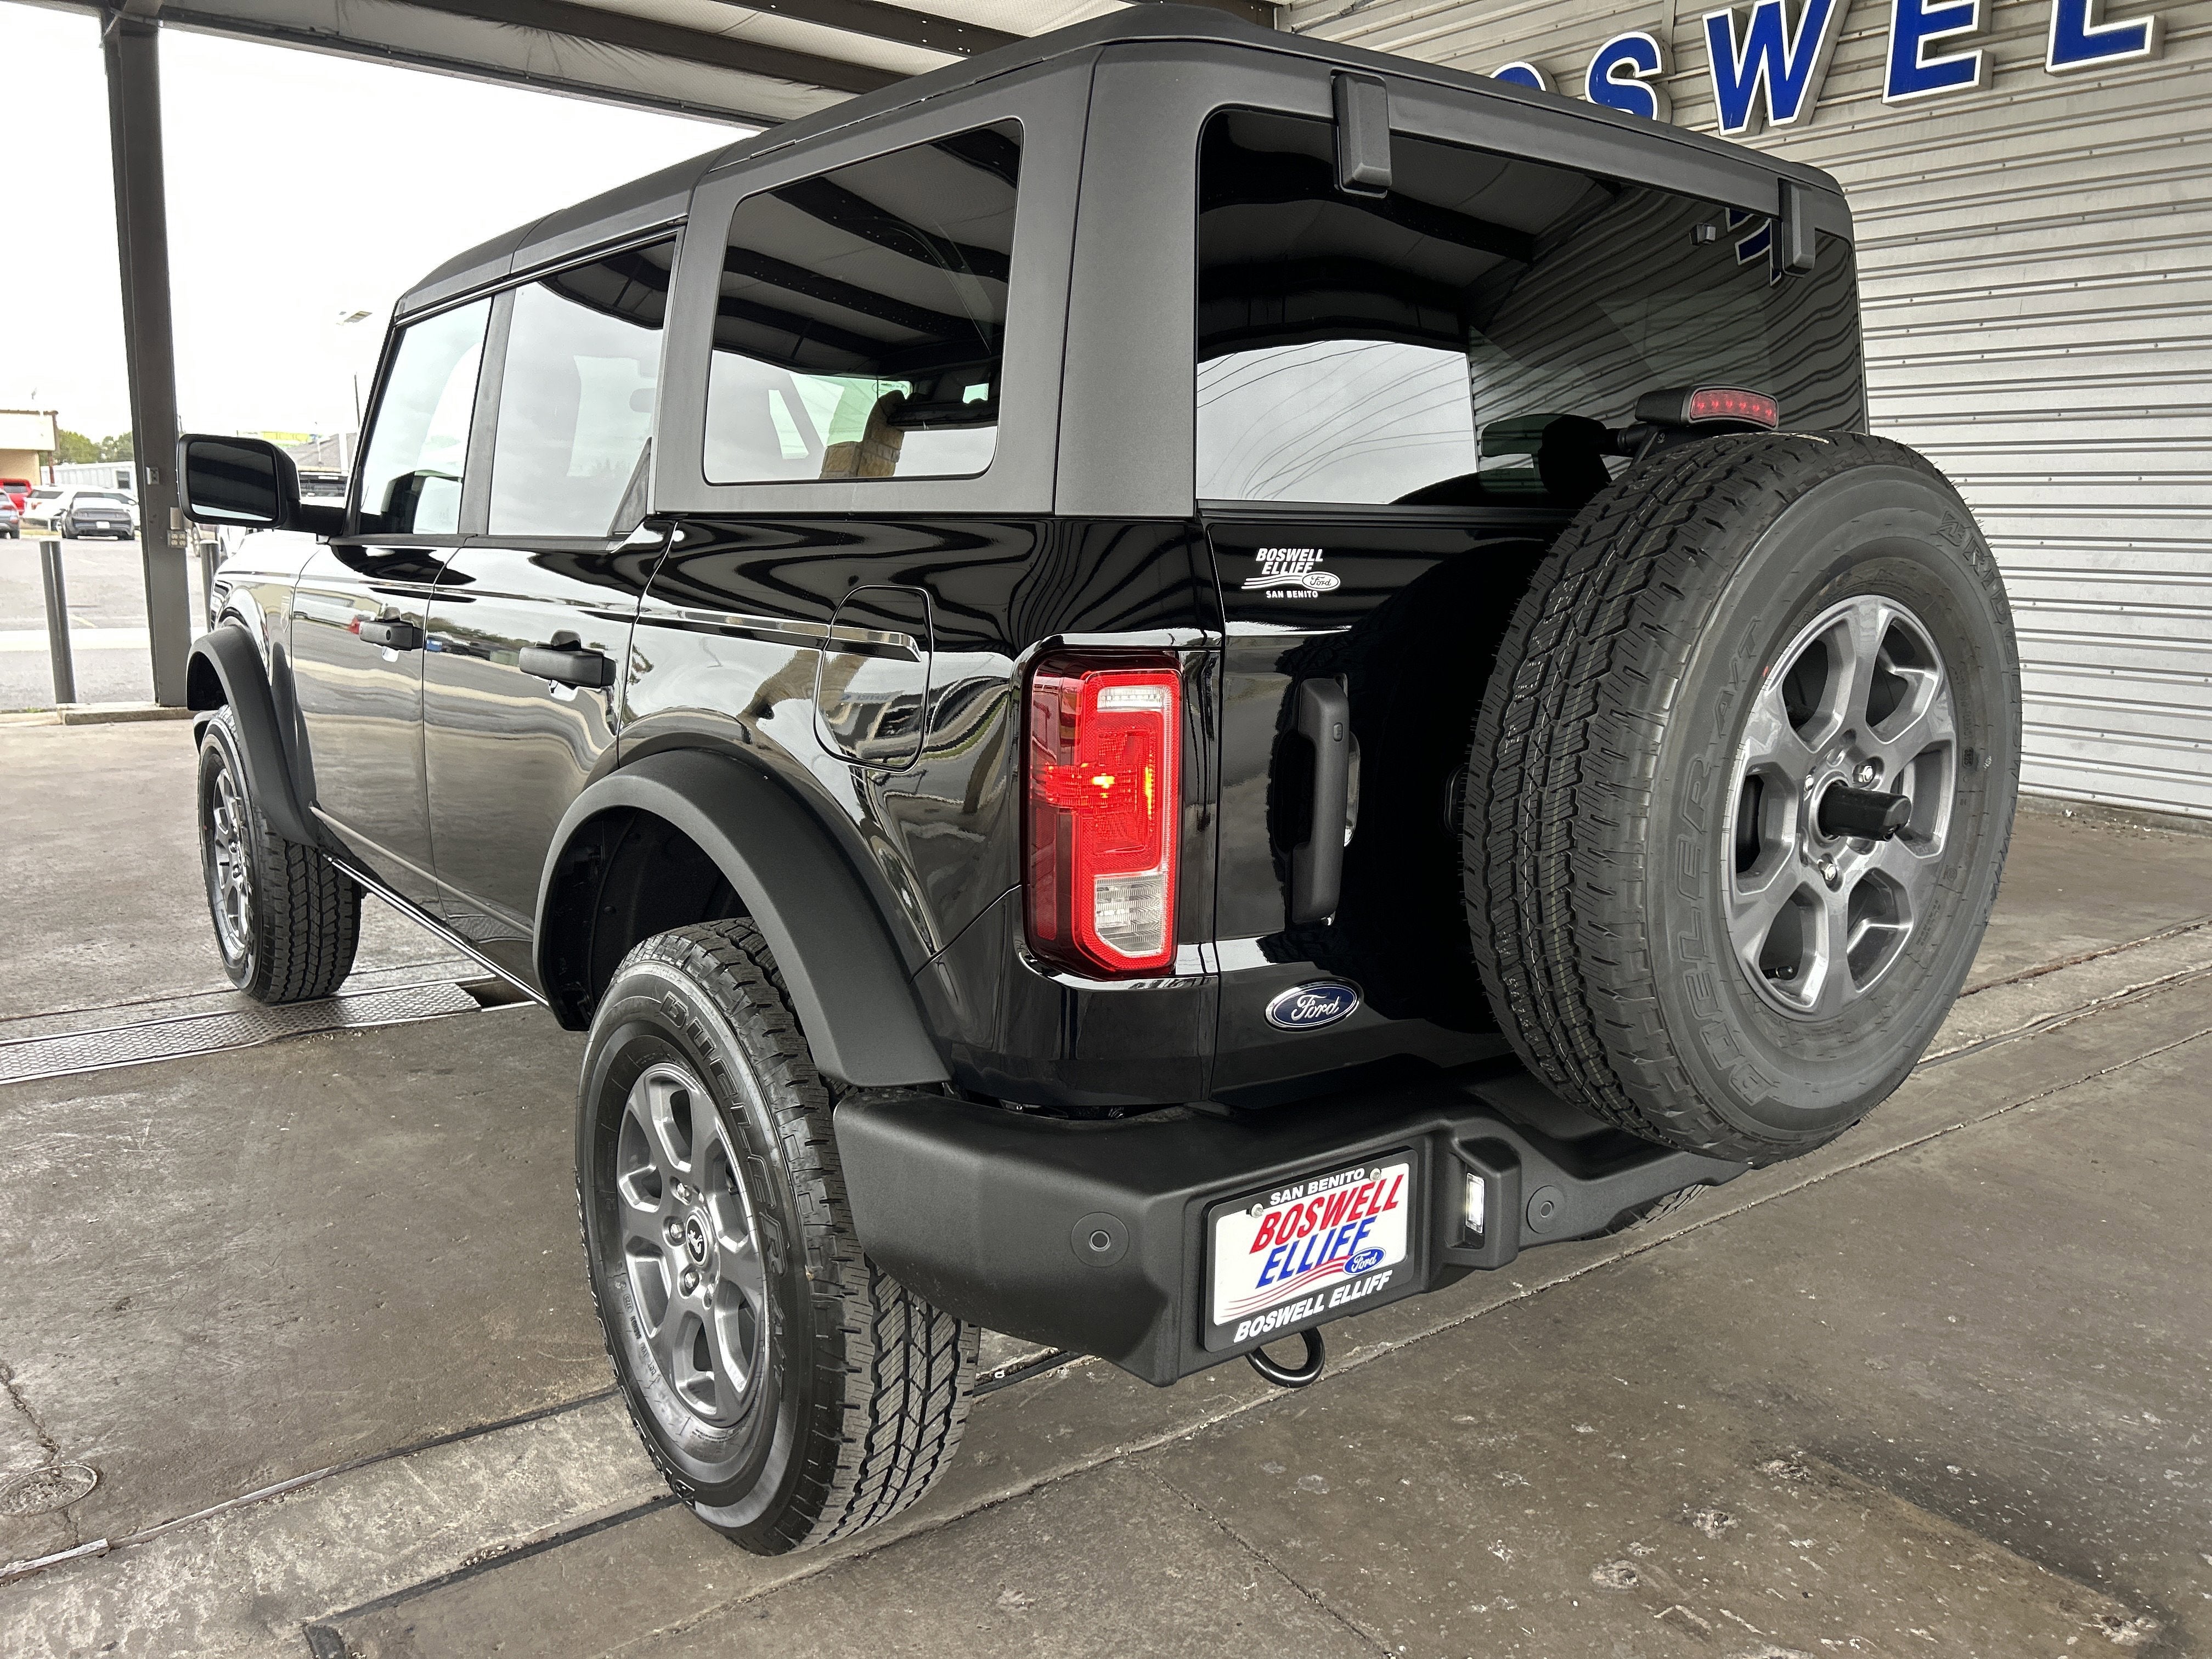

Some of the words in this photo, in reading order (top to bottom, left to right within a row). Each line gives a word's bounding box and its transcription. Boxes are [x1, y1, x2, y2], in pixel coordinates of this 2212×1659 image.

[1255, 548, 1323, 562] BOSWELL
[1261, 561, 1314, 574] ELLIFF
[1310, 575, 1331, 586] Ford
[1266, 590, 1284, 599] SAN
[1286, 590, 1318, 599] BENITO
[1291, 994, 1341, 1021] Ford
[1270, 1184, 1304, 1206] SAN
[1307, 1167, 1365, 1195] BENITO
[1249, 1173, 1404, 1254] BOSWELL
[1255, 1216, 1377, 1289] ELLIFF
[1351, 1250, 1378, 1273] Ford
[1233, 1293, 1325, 1344] BOSWELL
[1328, 1269, 1393, 1309] ELLIFF
